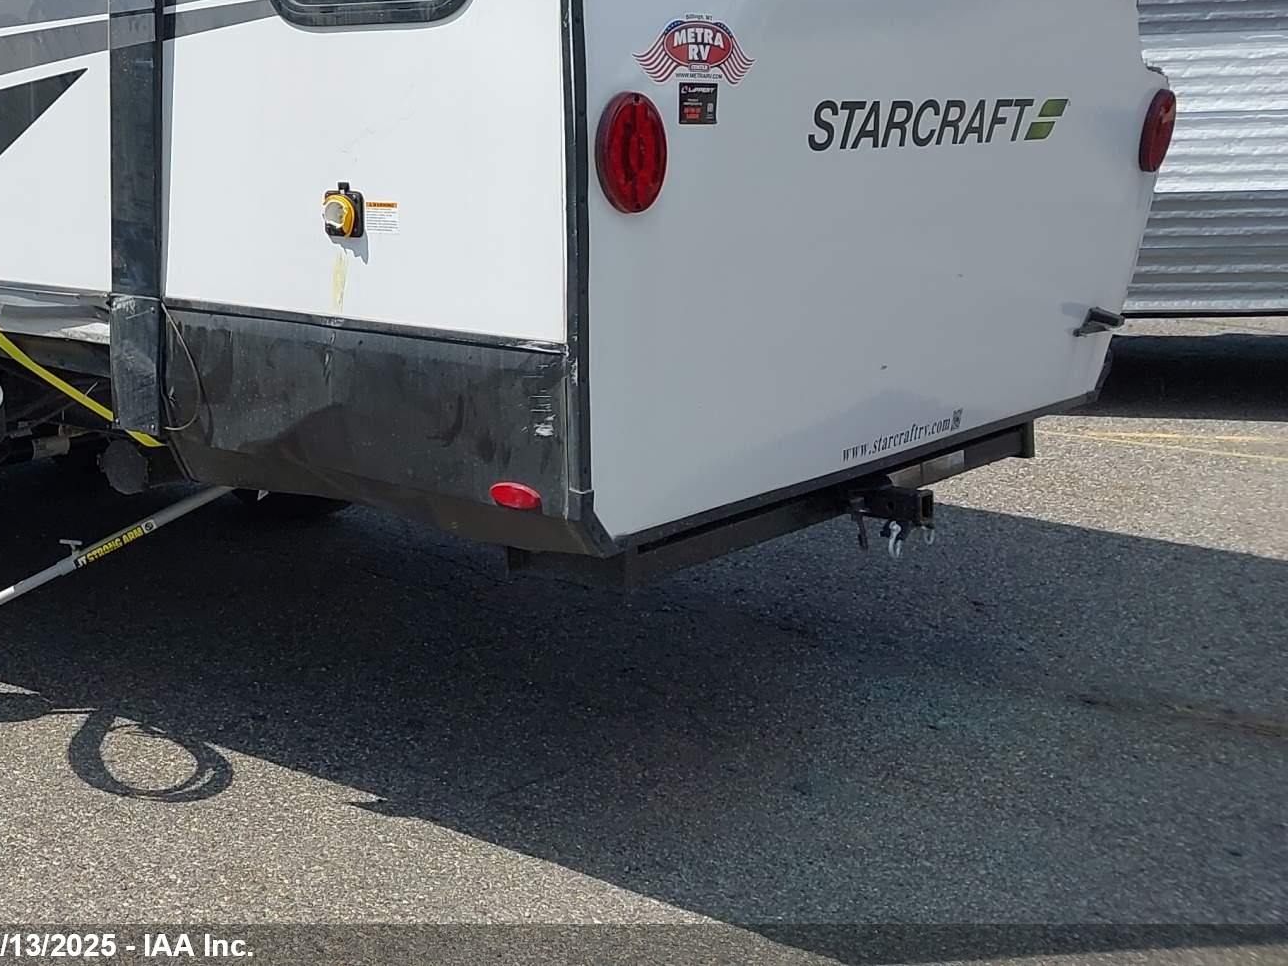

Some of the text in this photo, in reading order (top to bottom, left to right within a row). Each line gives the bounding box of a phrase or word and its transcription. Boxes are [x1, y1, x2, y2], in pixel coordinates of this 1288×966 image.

[673, 27, 725, 49] METRA
[688, 44, 710, 61] RV
[808, 98, 1034, 152] STARCRAFT
[842, 417, 951, 462] www.starcraftrv.com
[86, 537, 123, 563] STRONG
[122, 526, 144, 545] ARM
